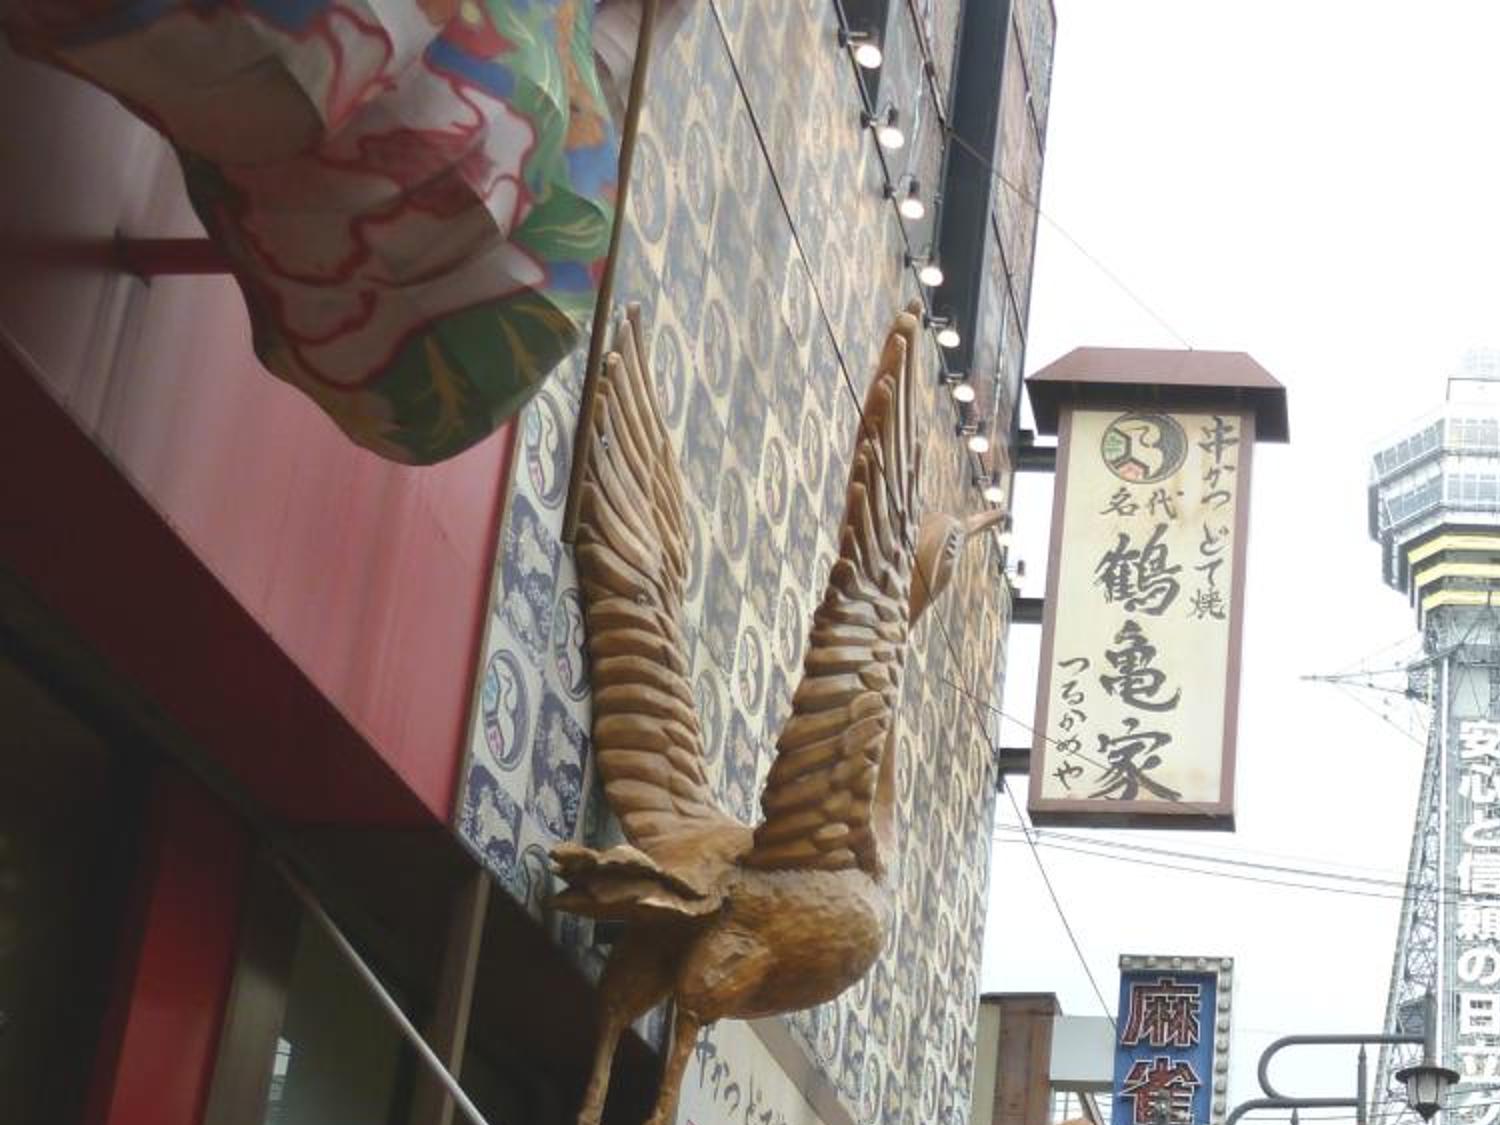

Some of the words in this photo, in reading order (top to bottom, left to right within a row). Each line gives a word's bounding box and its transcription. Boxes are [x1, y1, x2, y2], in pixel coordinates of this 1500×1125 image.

[1100, 487, 1184, 520] 名代
[1199, 416, 1238, 508] 串かつ
[1088, 525, 1183, 802] 鶴亀家
[1052, 657, 1091, 791] つるかめや
